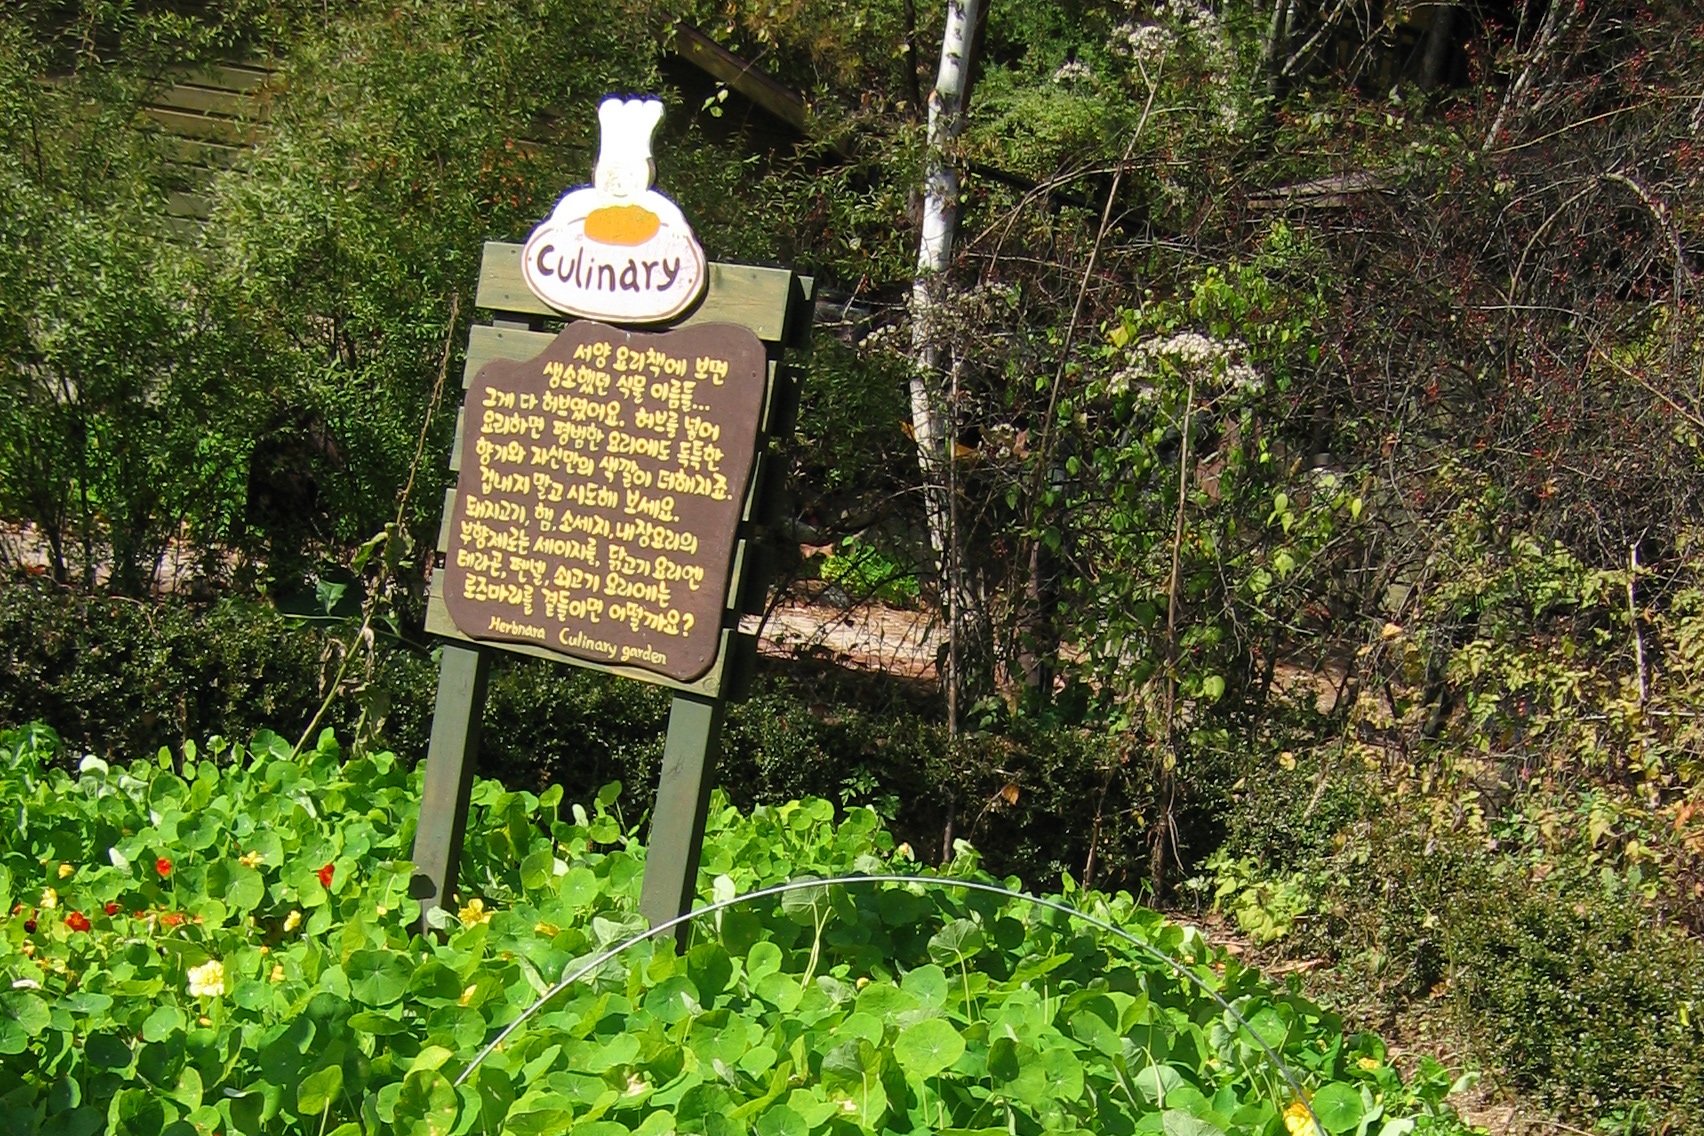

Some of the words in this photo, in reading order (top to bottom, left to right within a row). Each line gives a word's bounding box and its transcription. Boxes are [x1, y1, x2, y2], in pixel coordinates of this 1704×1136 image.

[537, 244, 681, 292] Culinary
[542, 361, 611, 396] 생소했던
[616, 374, 647, 404] 식물
[650, 378, 710, 412] 이름들...
[573, 341, 612, 368] 서양
[612, 345, 688, 378] 요리책에
[693, 356, 729, 386] 보면
[480, 410, 545, 440] 요리하면
[552, 420, 605, 451] 평범한
[606, 431, 672, 461] 요리에도
[676, 440, 725, 472] 독특한
[482, 386, 515, 409] 그게
[519, 393, 538, 411] 다
[542, 390, 625, 428] 허브였어요.
[635, 406, 680, 439] 허브를
[684, 415, 720, 442] 넣어
[475, 436, 526, 465] 향기와
[530, 445, 595, 477] 자신만의
[599, 455, 652, 488] 색깔이
[657, 468, 733, 500] 더해지죠.
[479, 465, 531, 495] 겁내지
[533, 472, 564, 502] 말고
[567, 482, 619, 508] 시도해
[624, 489, 680, 522] 보세요.
[465, 494, 530, 527] 돼지고기,
[456, 548, 507, 579] 테라곤,
[509, 556, 550, 587] 펜넬,
[553, 564, 600, 593] 쇠고기
[603, 572, 671, 608] 요리에는
[459, 520, 530, 555] 부향제로는
[533, 535, 600, 568] 세이지를,
[608, 543, 651, 577] 닭고기
[651, 555, 705, 591] 요리엔
[463, 572, 534, 616] 로즈마리를
[541, 587, 603, 624] 곁들이면
[608, 601, 695, 637] 어떨까요?
[488, 615, 546, 640] Herbnara
[558, 627, 618, 659] Culinary
[620, 644, 668, 666] garden
